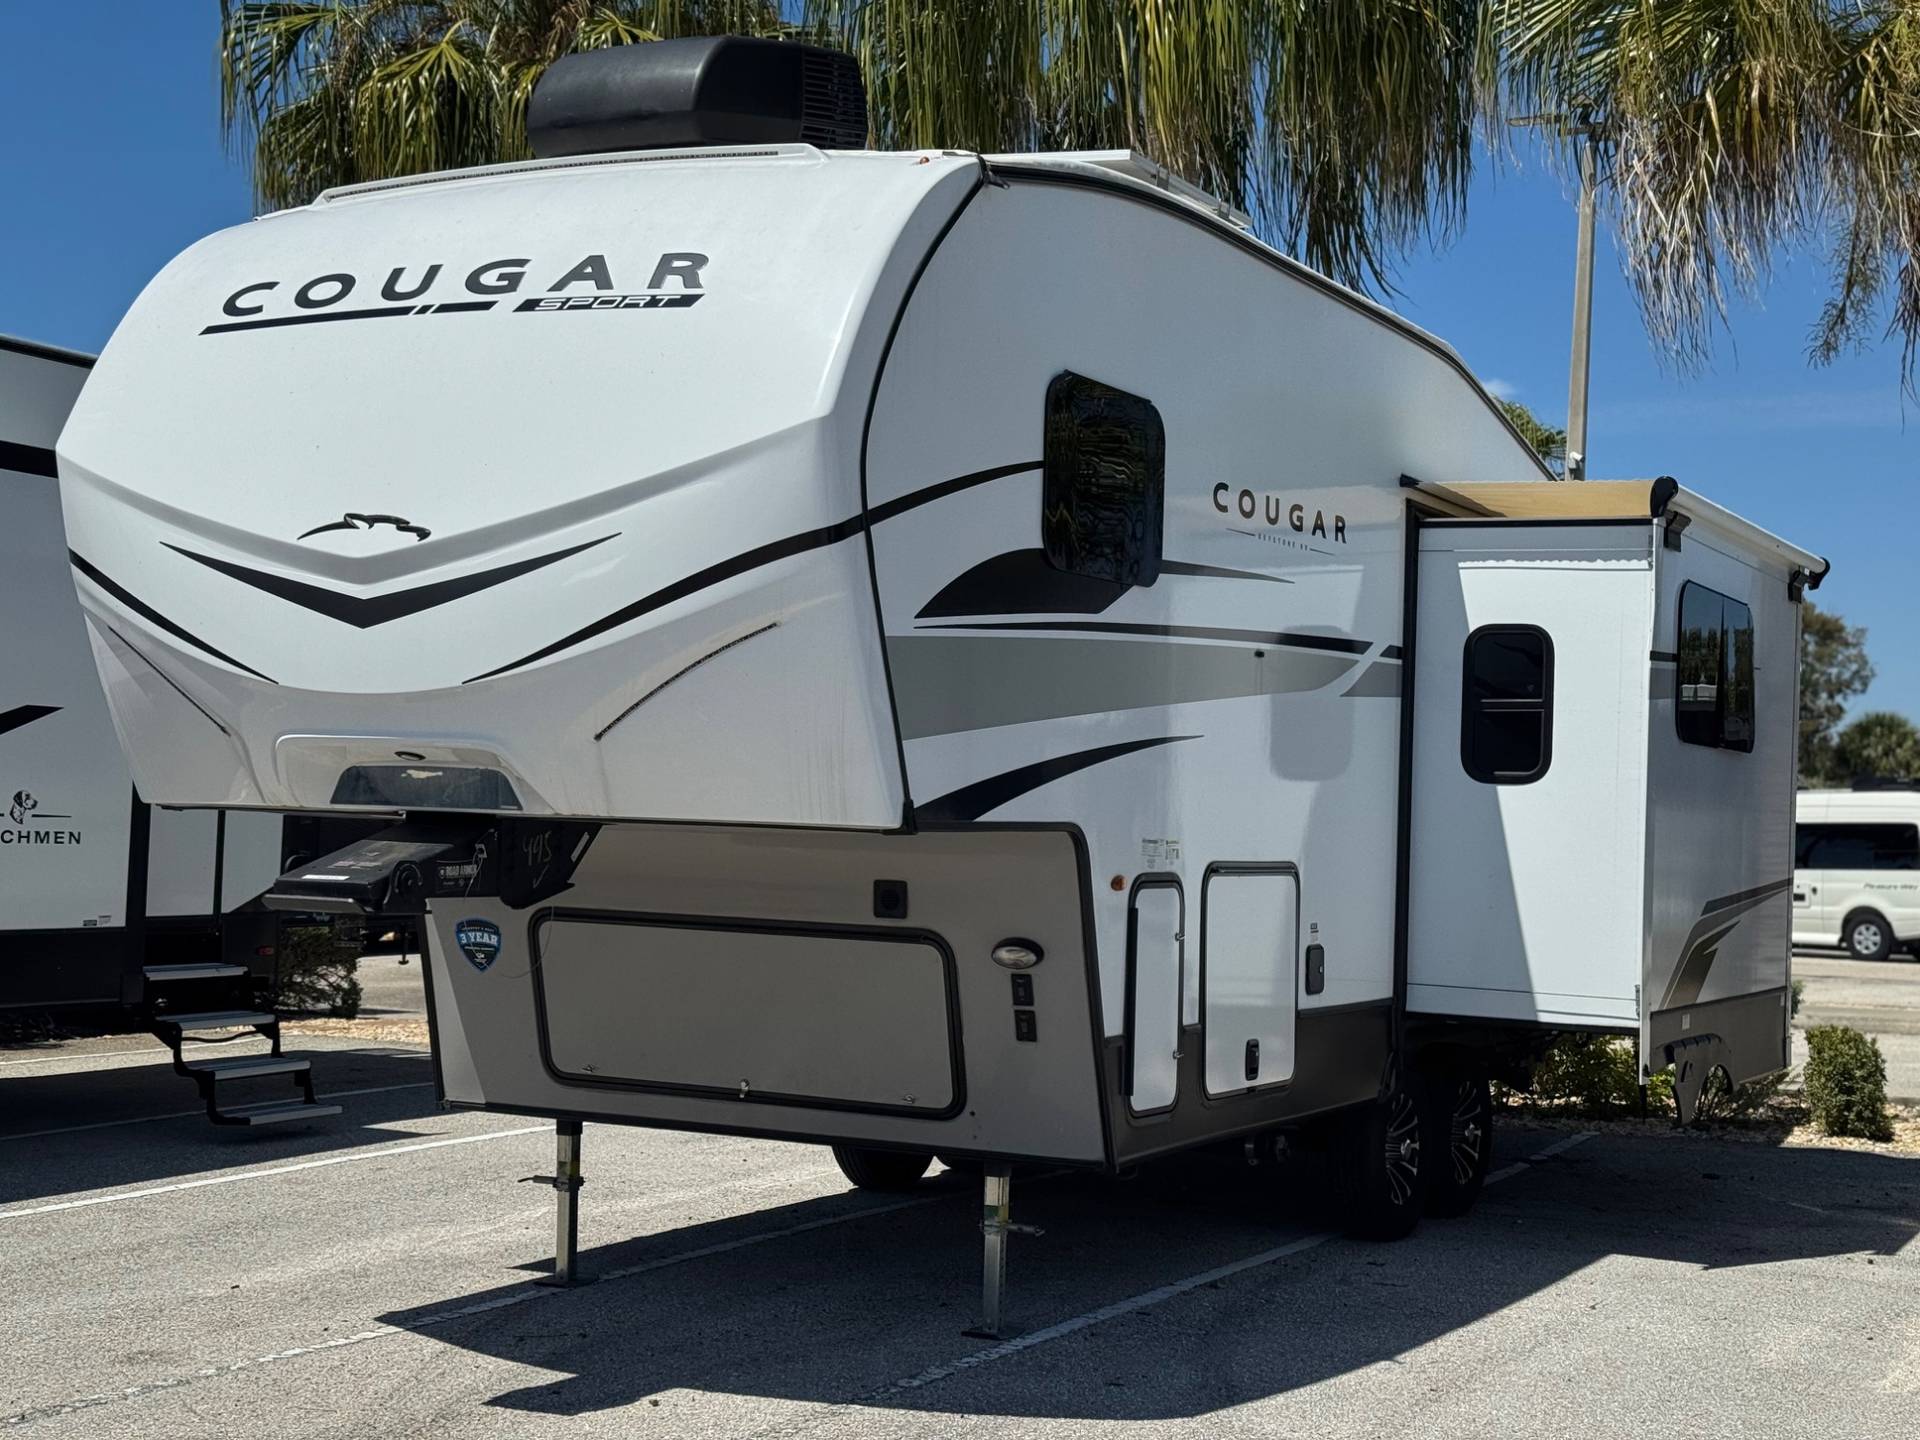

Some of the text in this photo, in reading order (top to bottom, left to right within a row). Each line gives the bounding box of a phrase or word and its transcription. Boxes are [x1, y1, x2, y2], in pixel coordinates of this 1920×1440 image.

[222, 252, 710, 317] COUGAR
[533, 295, 682, 312] SPORT
[1213, 482, 1347, 544] COUGAR
[1, 829, 82, 845] CHMEN
[459, 932, 498, 946] 3 YEAR
